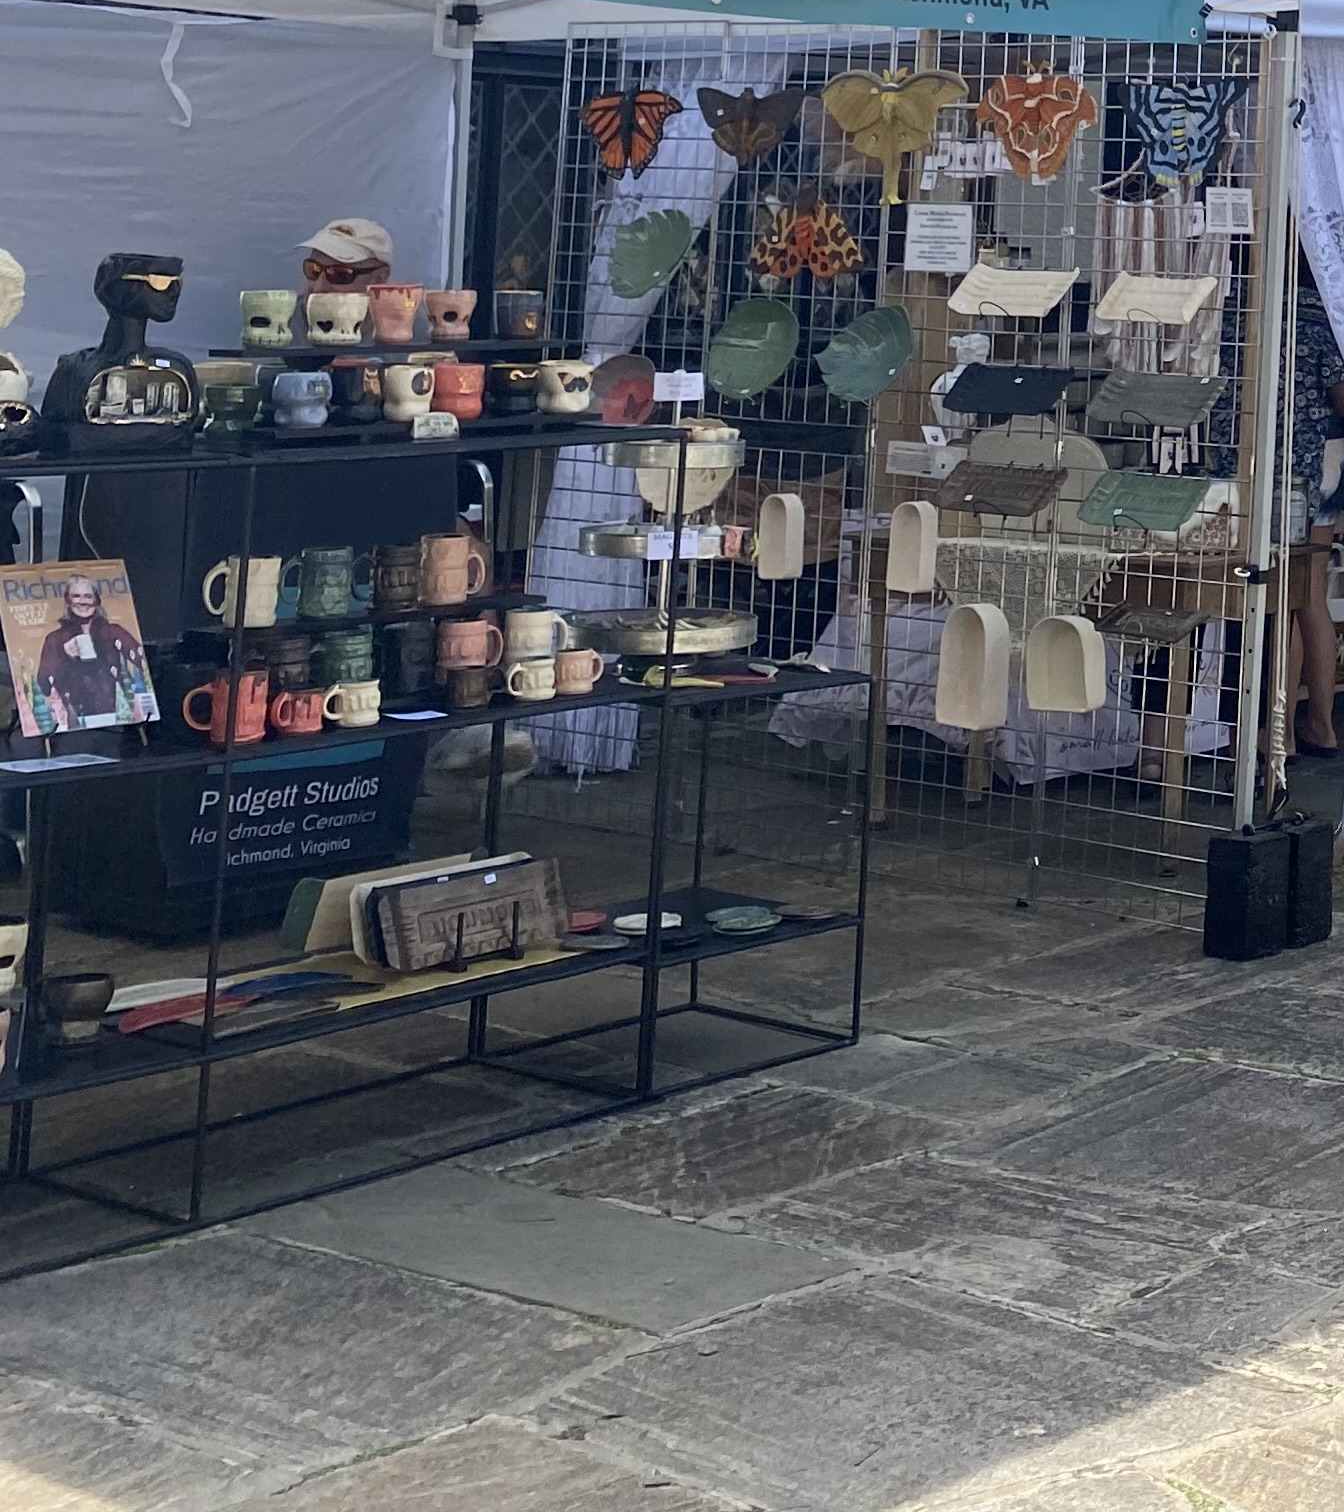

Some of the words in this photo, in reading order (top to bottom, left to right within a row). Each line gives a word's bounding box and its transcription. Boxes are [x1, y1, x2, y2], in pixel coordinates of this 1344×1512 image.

[3, 572, 130, 602] Richnd
[303, 774, 380, 805] Studios
[189, 818, 296, 846] Hadmade
[226, 843, 295, 867] ichmond,
[300, 838, 351, 857] Virginia
